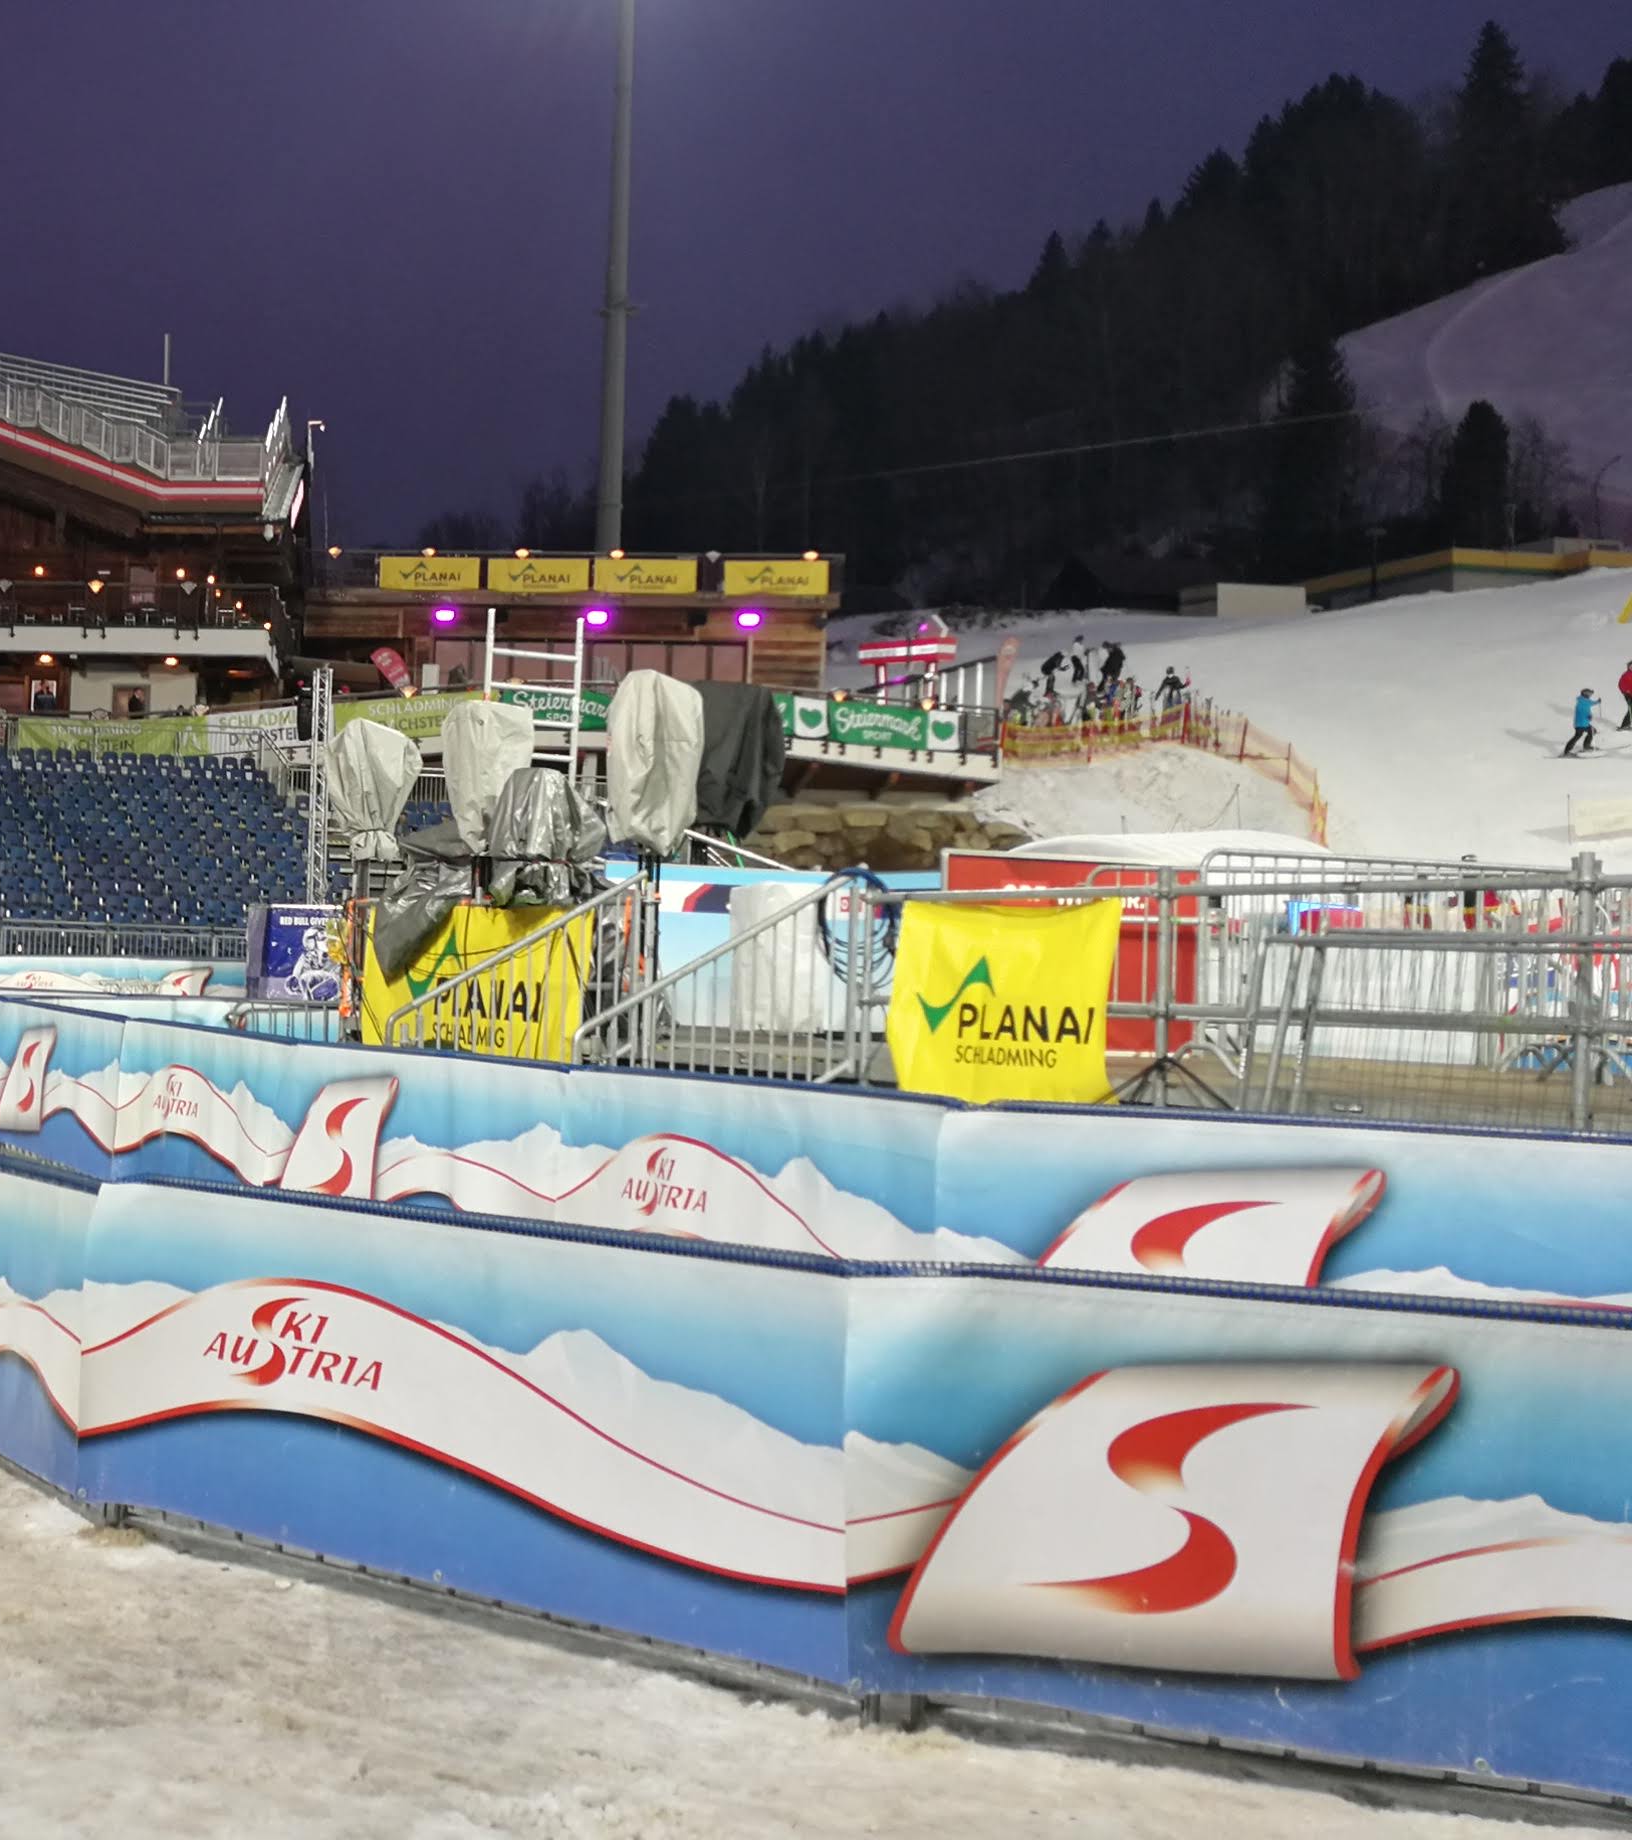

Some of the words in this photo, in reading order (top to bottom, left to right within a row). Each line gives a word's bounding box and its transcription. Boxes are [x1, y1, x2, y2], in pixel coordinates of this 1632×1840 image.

[414, 571, 461, 582] PLANAI
[522, 573, 571, 584] PLANAI
[512, 690, 609, 718] Steiermar
[219, 709, 298, 731] SCHLADMI
[378, 714, 448, 731] ACHSTE
[835, 706, 922, 741] Steiermark
[863, 730, 893, 741] SPORT
[279, 916, 293, 926] RED
[294, 916, 309, 926] BULL
[957, 1002, 1096, 1045] PLANAI
[954, 1045, 1058, 1069] SCHLADMING
[646, 1147, 675, 1181] SKI
[621, 1177, 709, 1216] AUSTRIA
[251, 1297, 329, 1345] SKI
[203, 1332, 384, 1392] AUSTRIA
